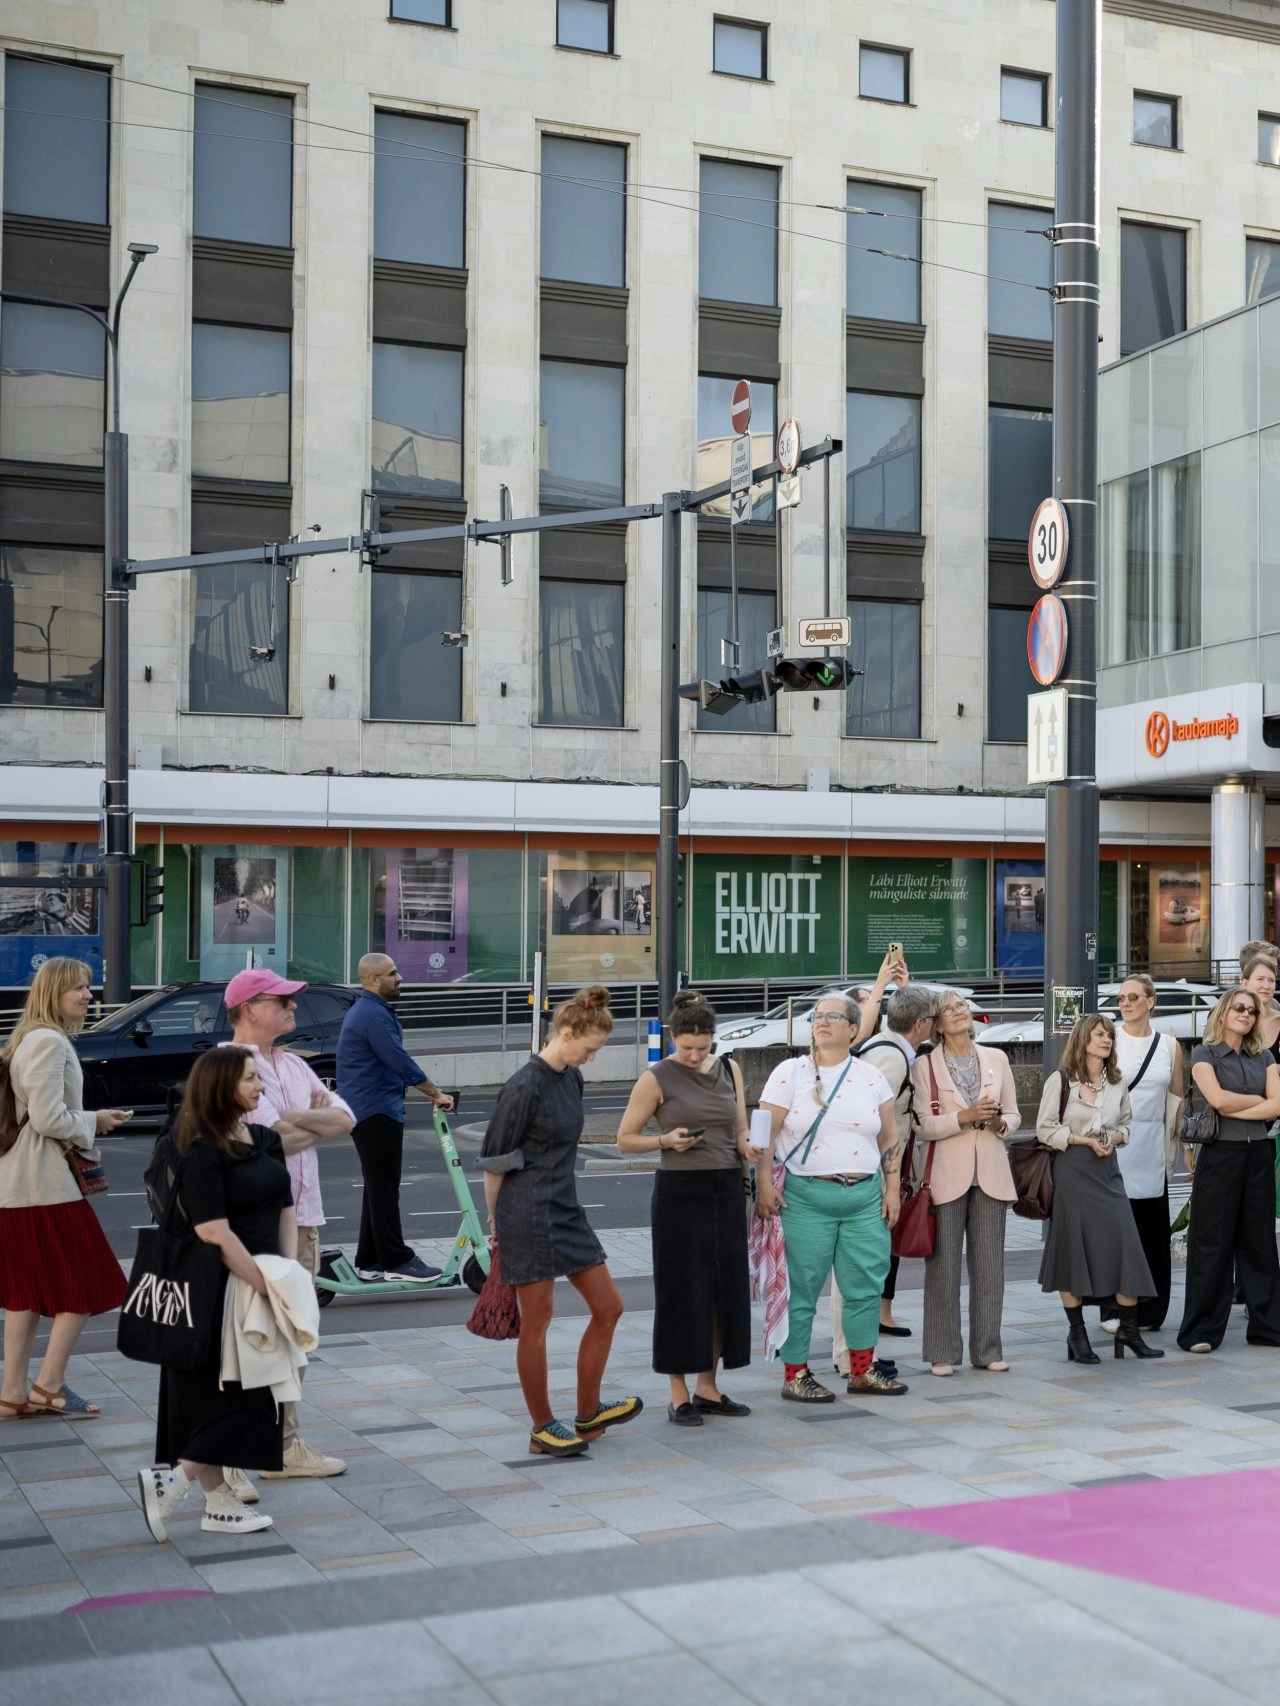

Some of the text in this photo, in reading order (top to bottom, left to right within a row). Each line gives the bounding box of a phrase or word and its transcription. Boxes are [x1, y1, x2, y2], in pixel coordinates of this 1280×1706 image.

[1038, 521, 1057, 564] 30
[716, 872, 821, 913] ELLIOTT
[869, 887, 969, 903] mänguliste silmade
[870, 874, 968, 887] Läbi Elliott Erwitti
[716, 913, 821, 954] ERWITT
[441, 1135, 452, 1153] Bolt
